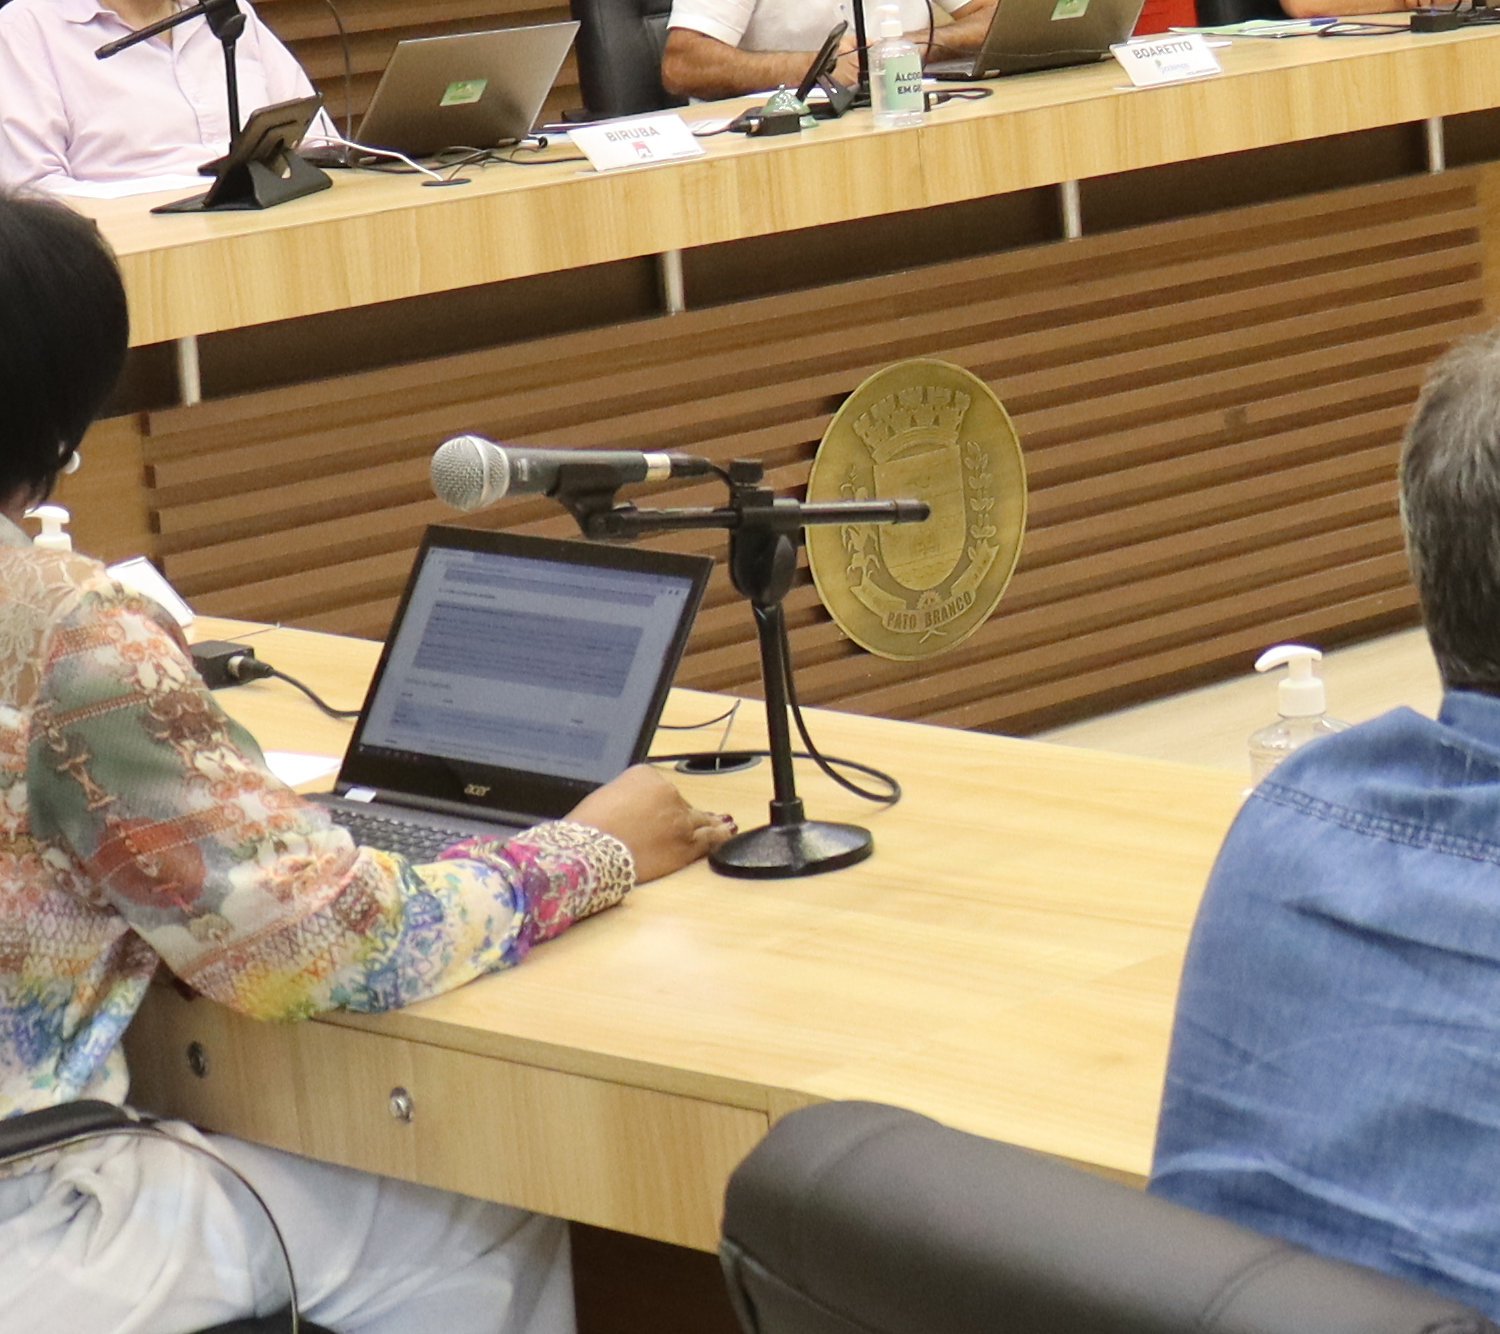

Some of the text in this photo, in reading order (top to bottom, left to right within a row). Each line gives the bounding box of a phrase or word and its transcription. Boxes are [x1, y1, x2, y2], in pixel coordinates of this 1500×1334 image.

[1132, 41, 1193, 59] BOARETTO
[604, 126, 661, 142] BIRUBA
[887, 591, 973, 629] PATO BRANCO
